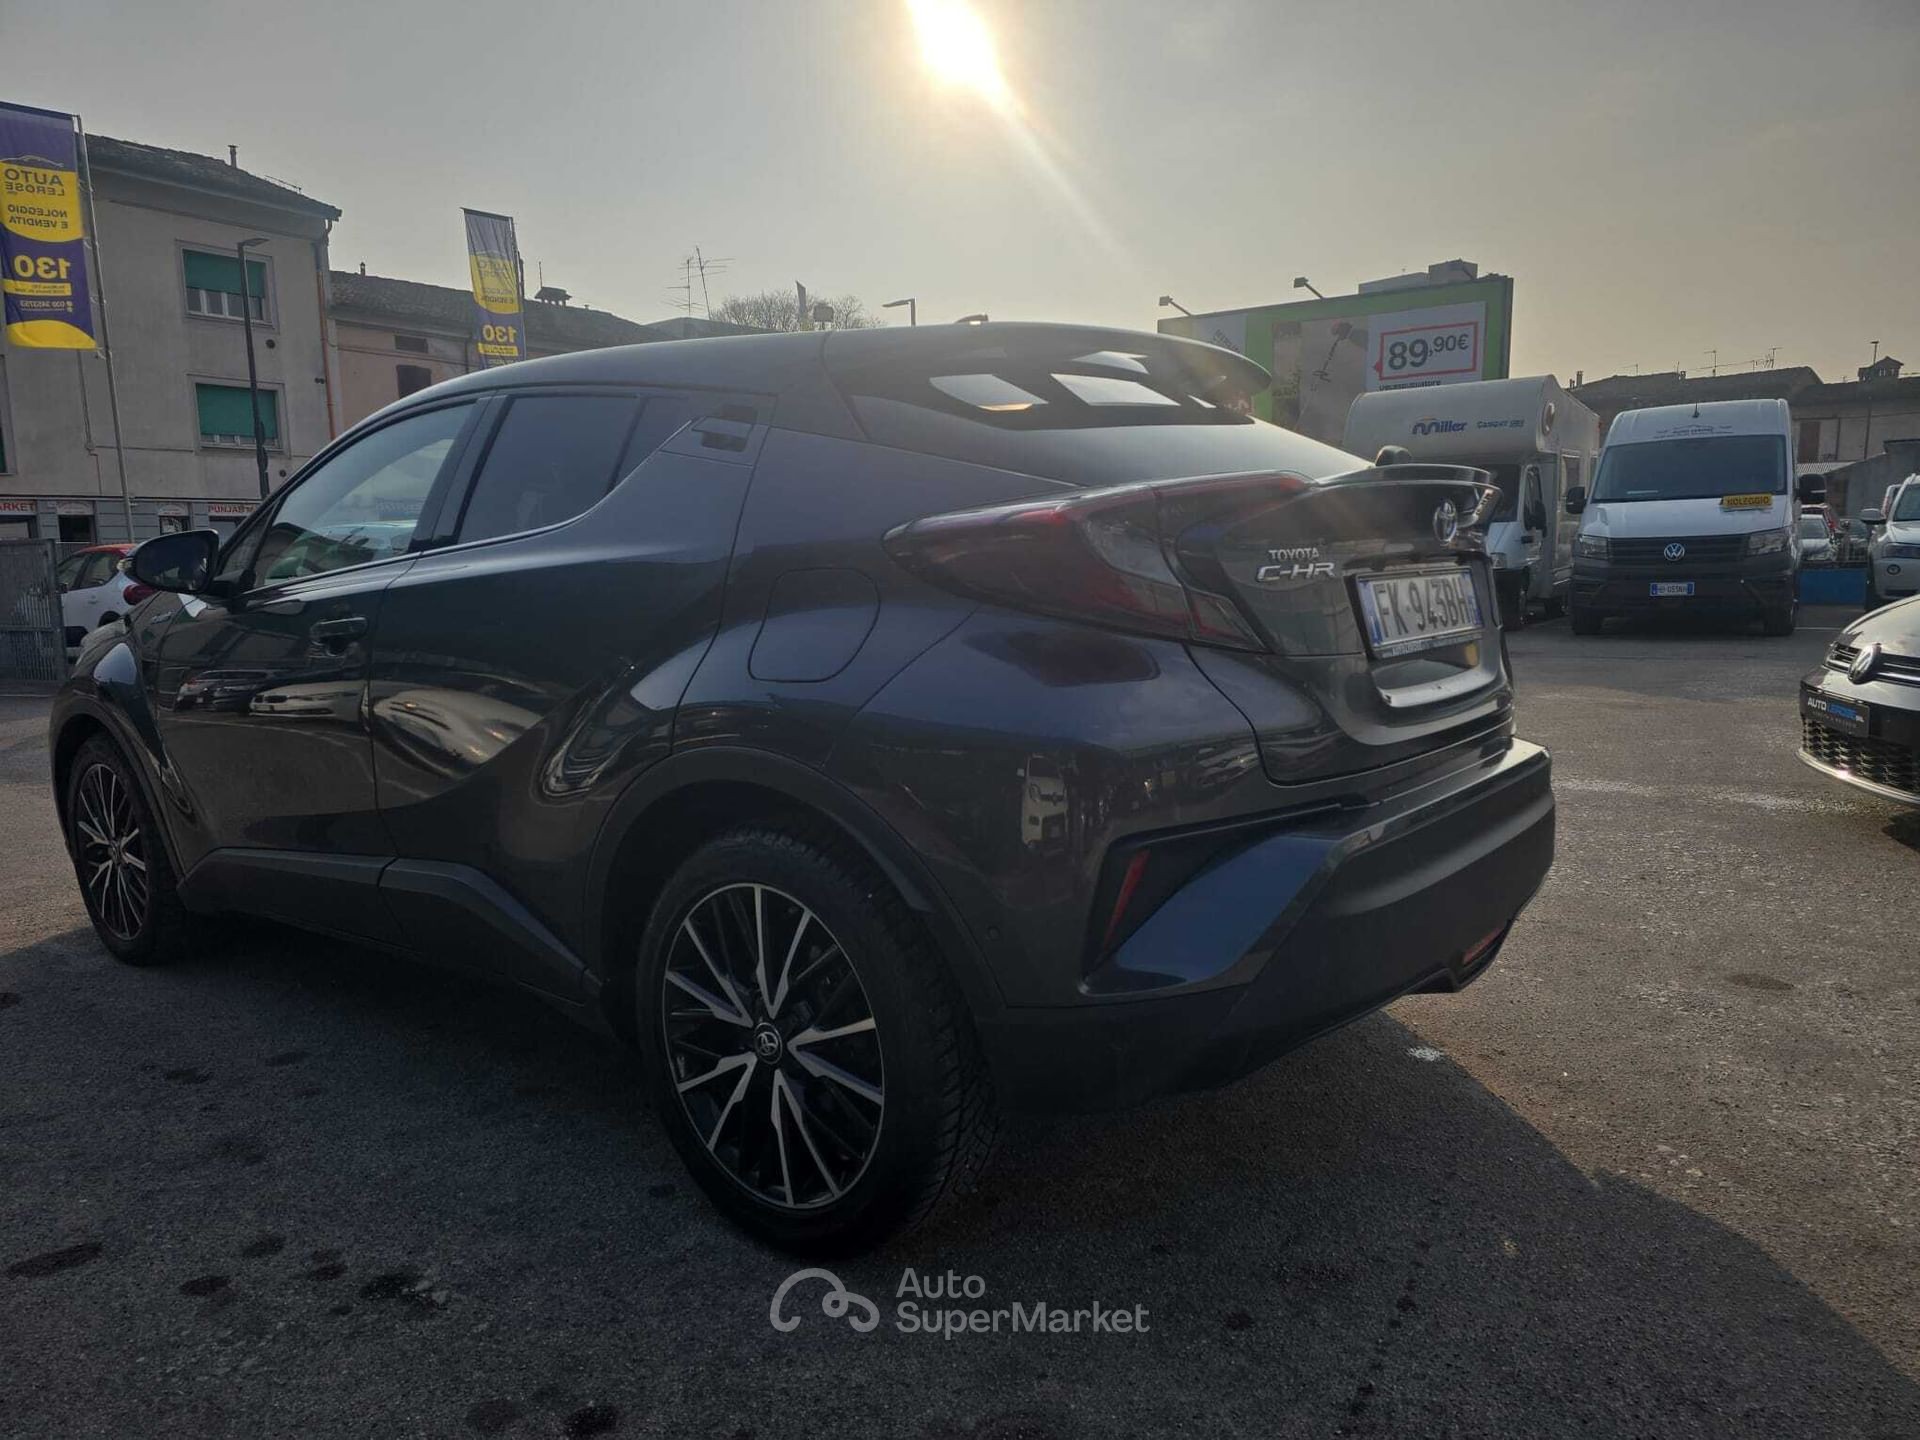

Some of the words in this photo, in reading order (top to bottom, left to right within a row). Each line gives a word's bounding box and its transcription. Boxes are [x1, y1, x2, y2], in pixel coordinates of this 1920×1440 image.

[1388, 333, 1470, 371] 89,90€
[1268, 547, 1320, 560] TOYOTA
[1257, 562, 1336, 582] C-HR
[1808, 697, 1827, 711] AUTO
